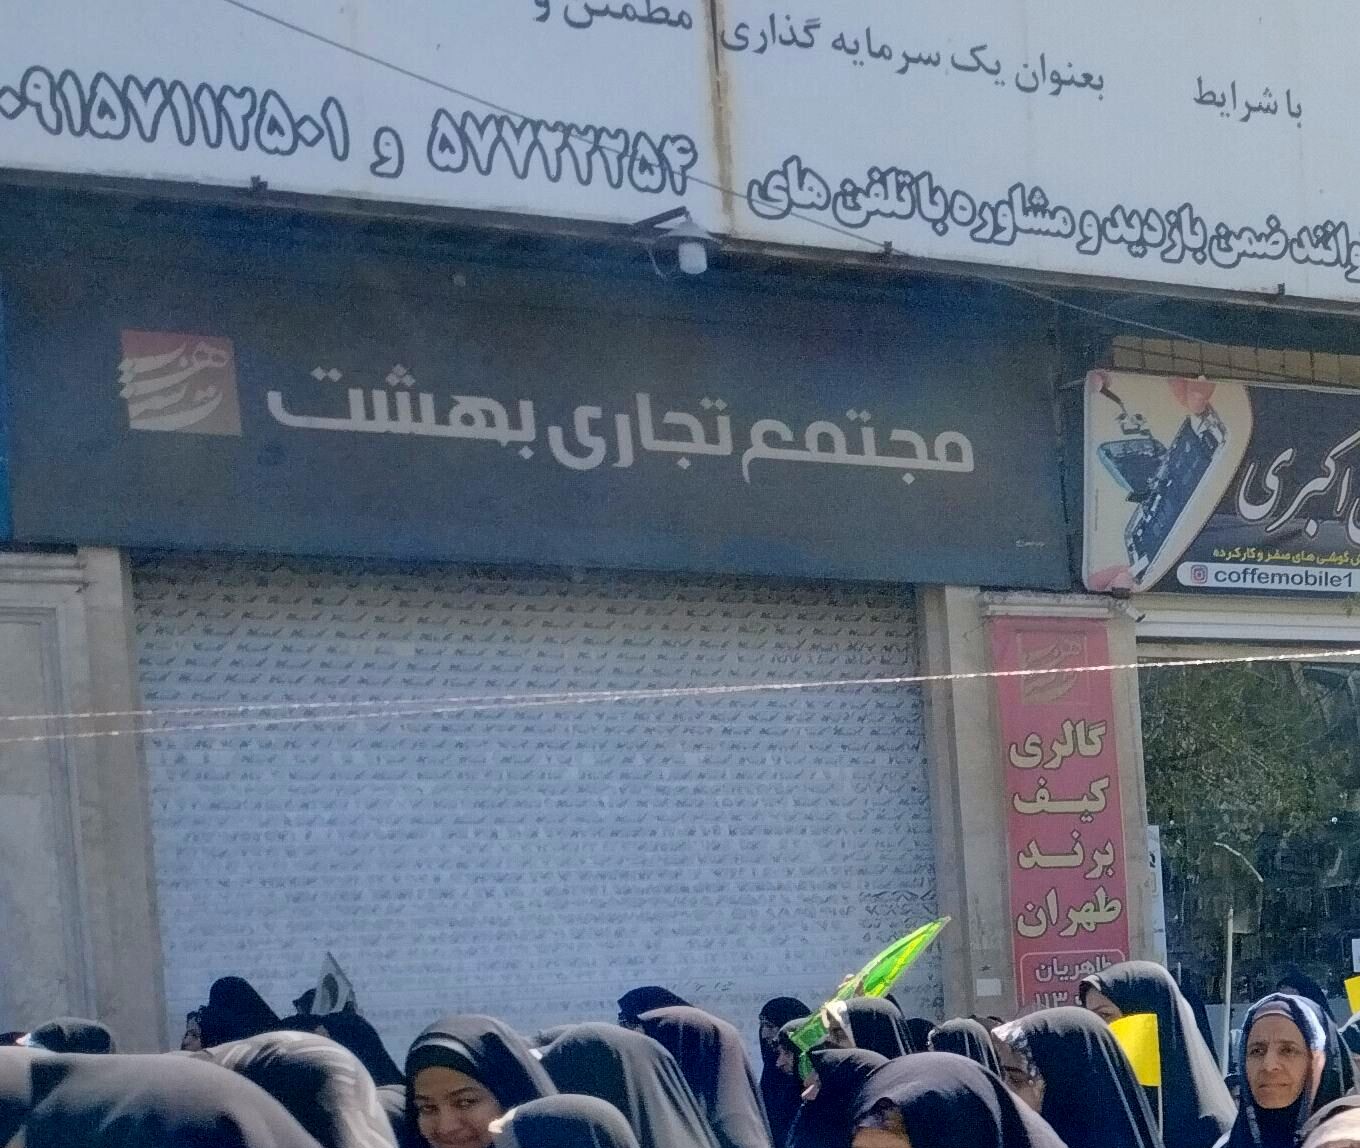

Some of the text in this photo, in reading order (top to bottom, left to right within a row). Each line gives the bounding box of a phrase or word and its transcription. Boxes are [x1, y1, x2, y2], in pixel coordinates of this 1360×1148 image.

[720, 12, 822, 54] گذاری
[831, 27, 942, 75] سرمایه
[950, 45, 1004, 86] یک
[1015, 54, 1104, 101] بعنوان
[1193, 76, 1280, 123] شرایط
[370, 126, 404, 178] و
[949, 182, 1075, 246] مشاوره
[1076, 210, 1101, 255] و
[1101, 203, 1208, 264] بازدید
[1209, 214, 1289, 269] ضمن
[266, 364, 535, 460] بهشت
[549, 392, 732, 472] تجاری
[742, 408, 975, 485] مجتمع
[1214, 568, 1353, 587] coffemobile1
[1008, 718, 1106, 771] گالری
[1012, 776, 1111, 824] کیف
[1017, 829, 1115, 880] برند
[1015, 885, 1123, 939] طهران
